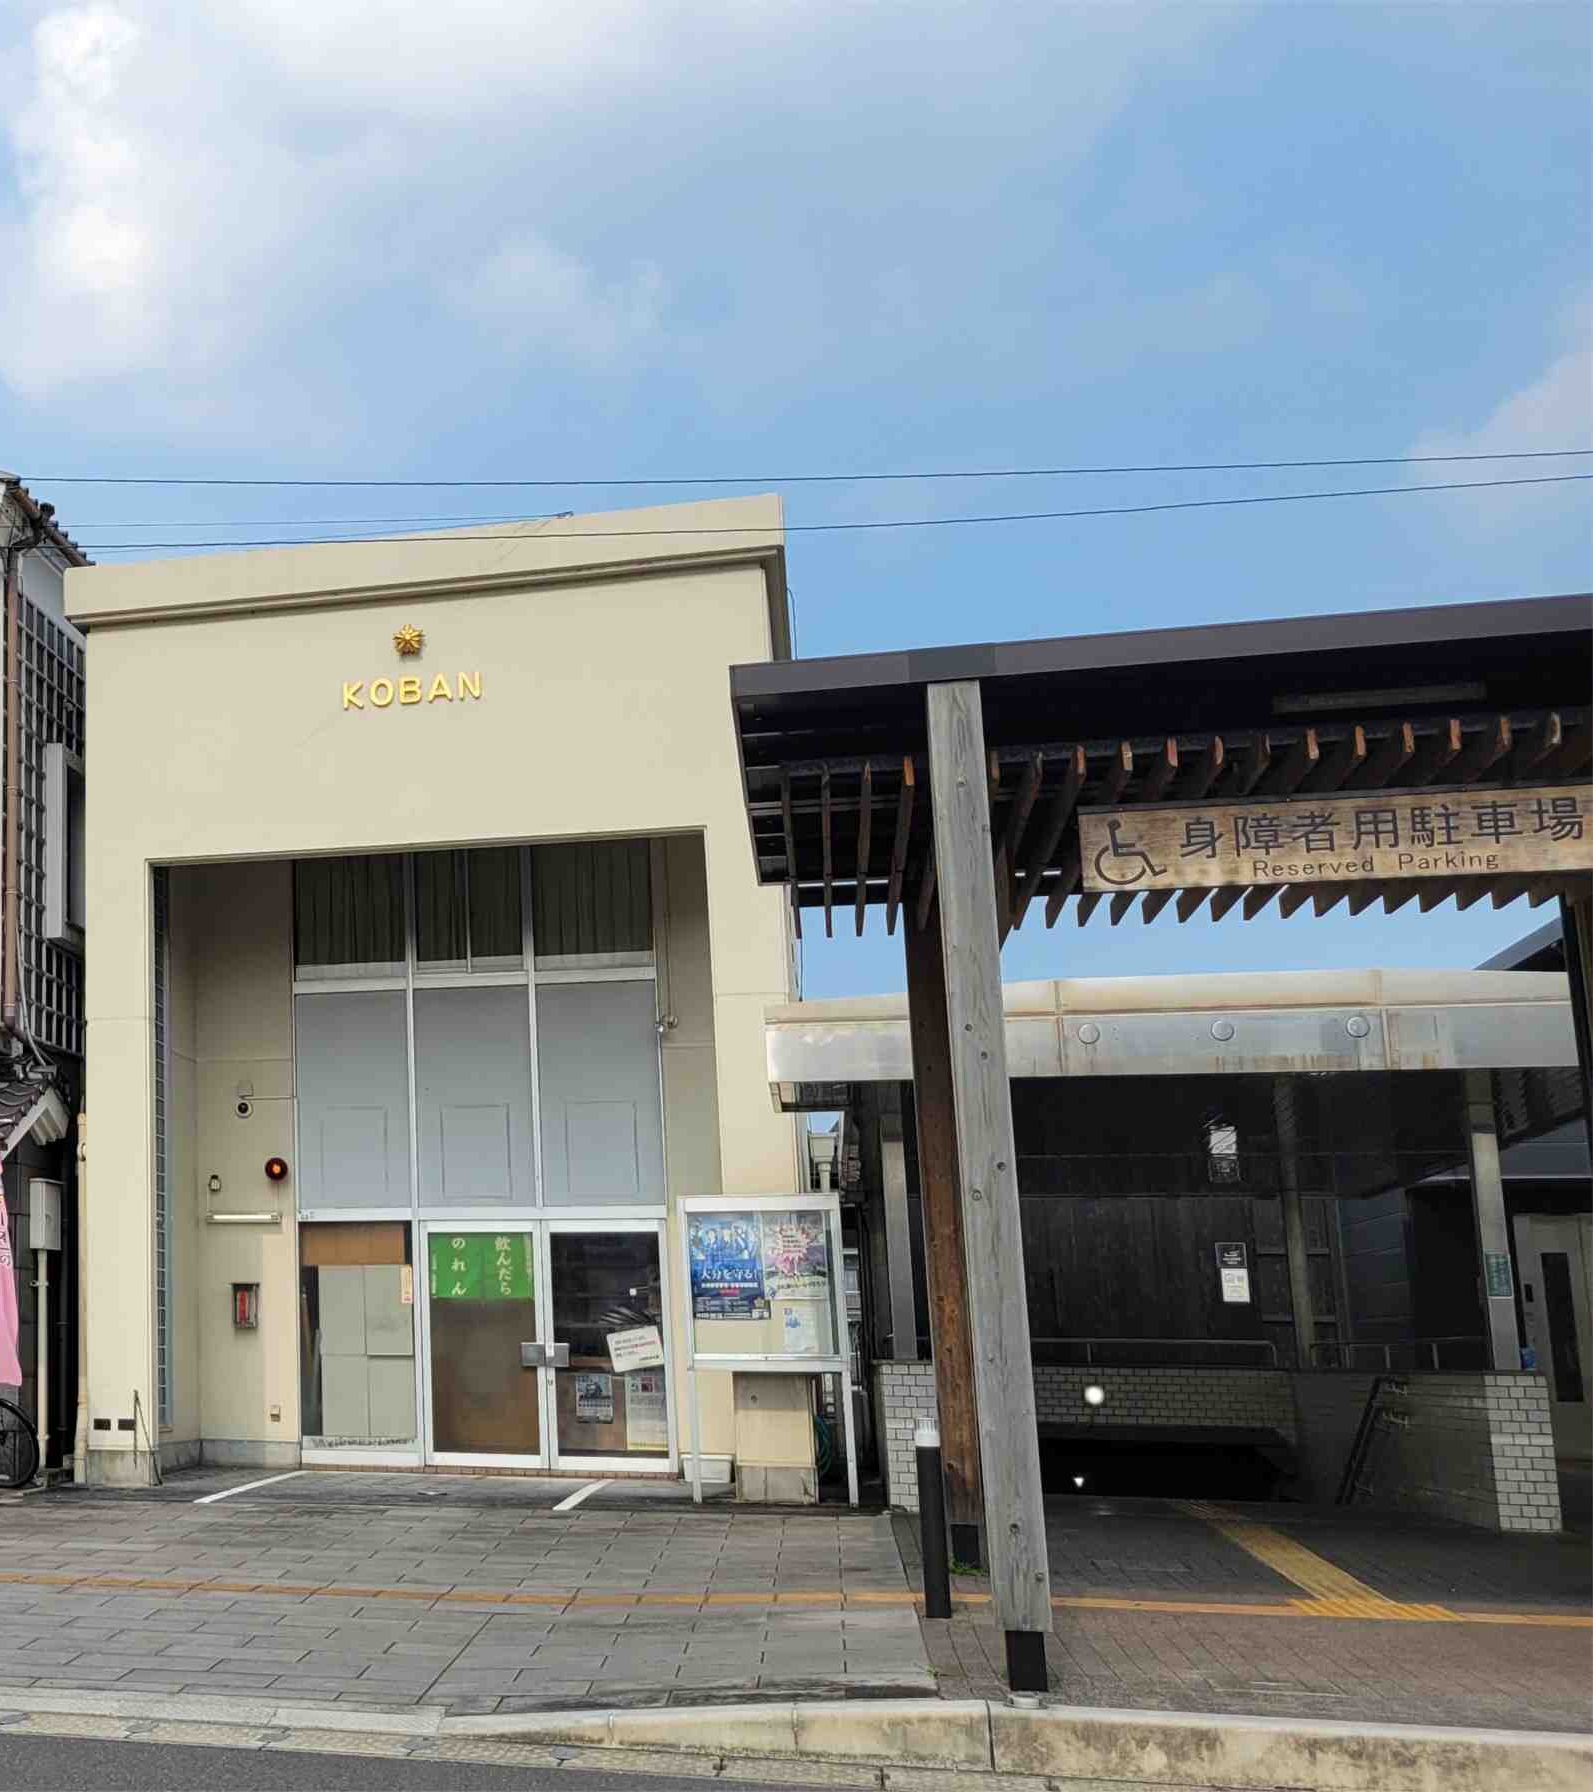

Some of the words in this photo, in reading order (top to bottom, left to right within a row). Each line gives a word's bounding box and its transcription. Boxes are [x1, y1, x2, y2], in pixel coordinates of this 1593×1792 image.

[343, 672, 481, 711] KOBAN
[1180, 796, 1585, 859] 身障者用駐車場
[1253, 857, 1376, 879] Reserved
[1398, 852, 1500, 872] Parking
[450, 1237, 467, 1296] のれん
